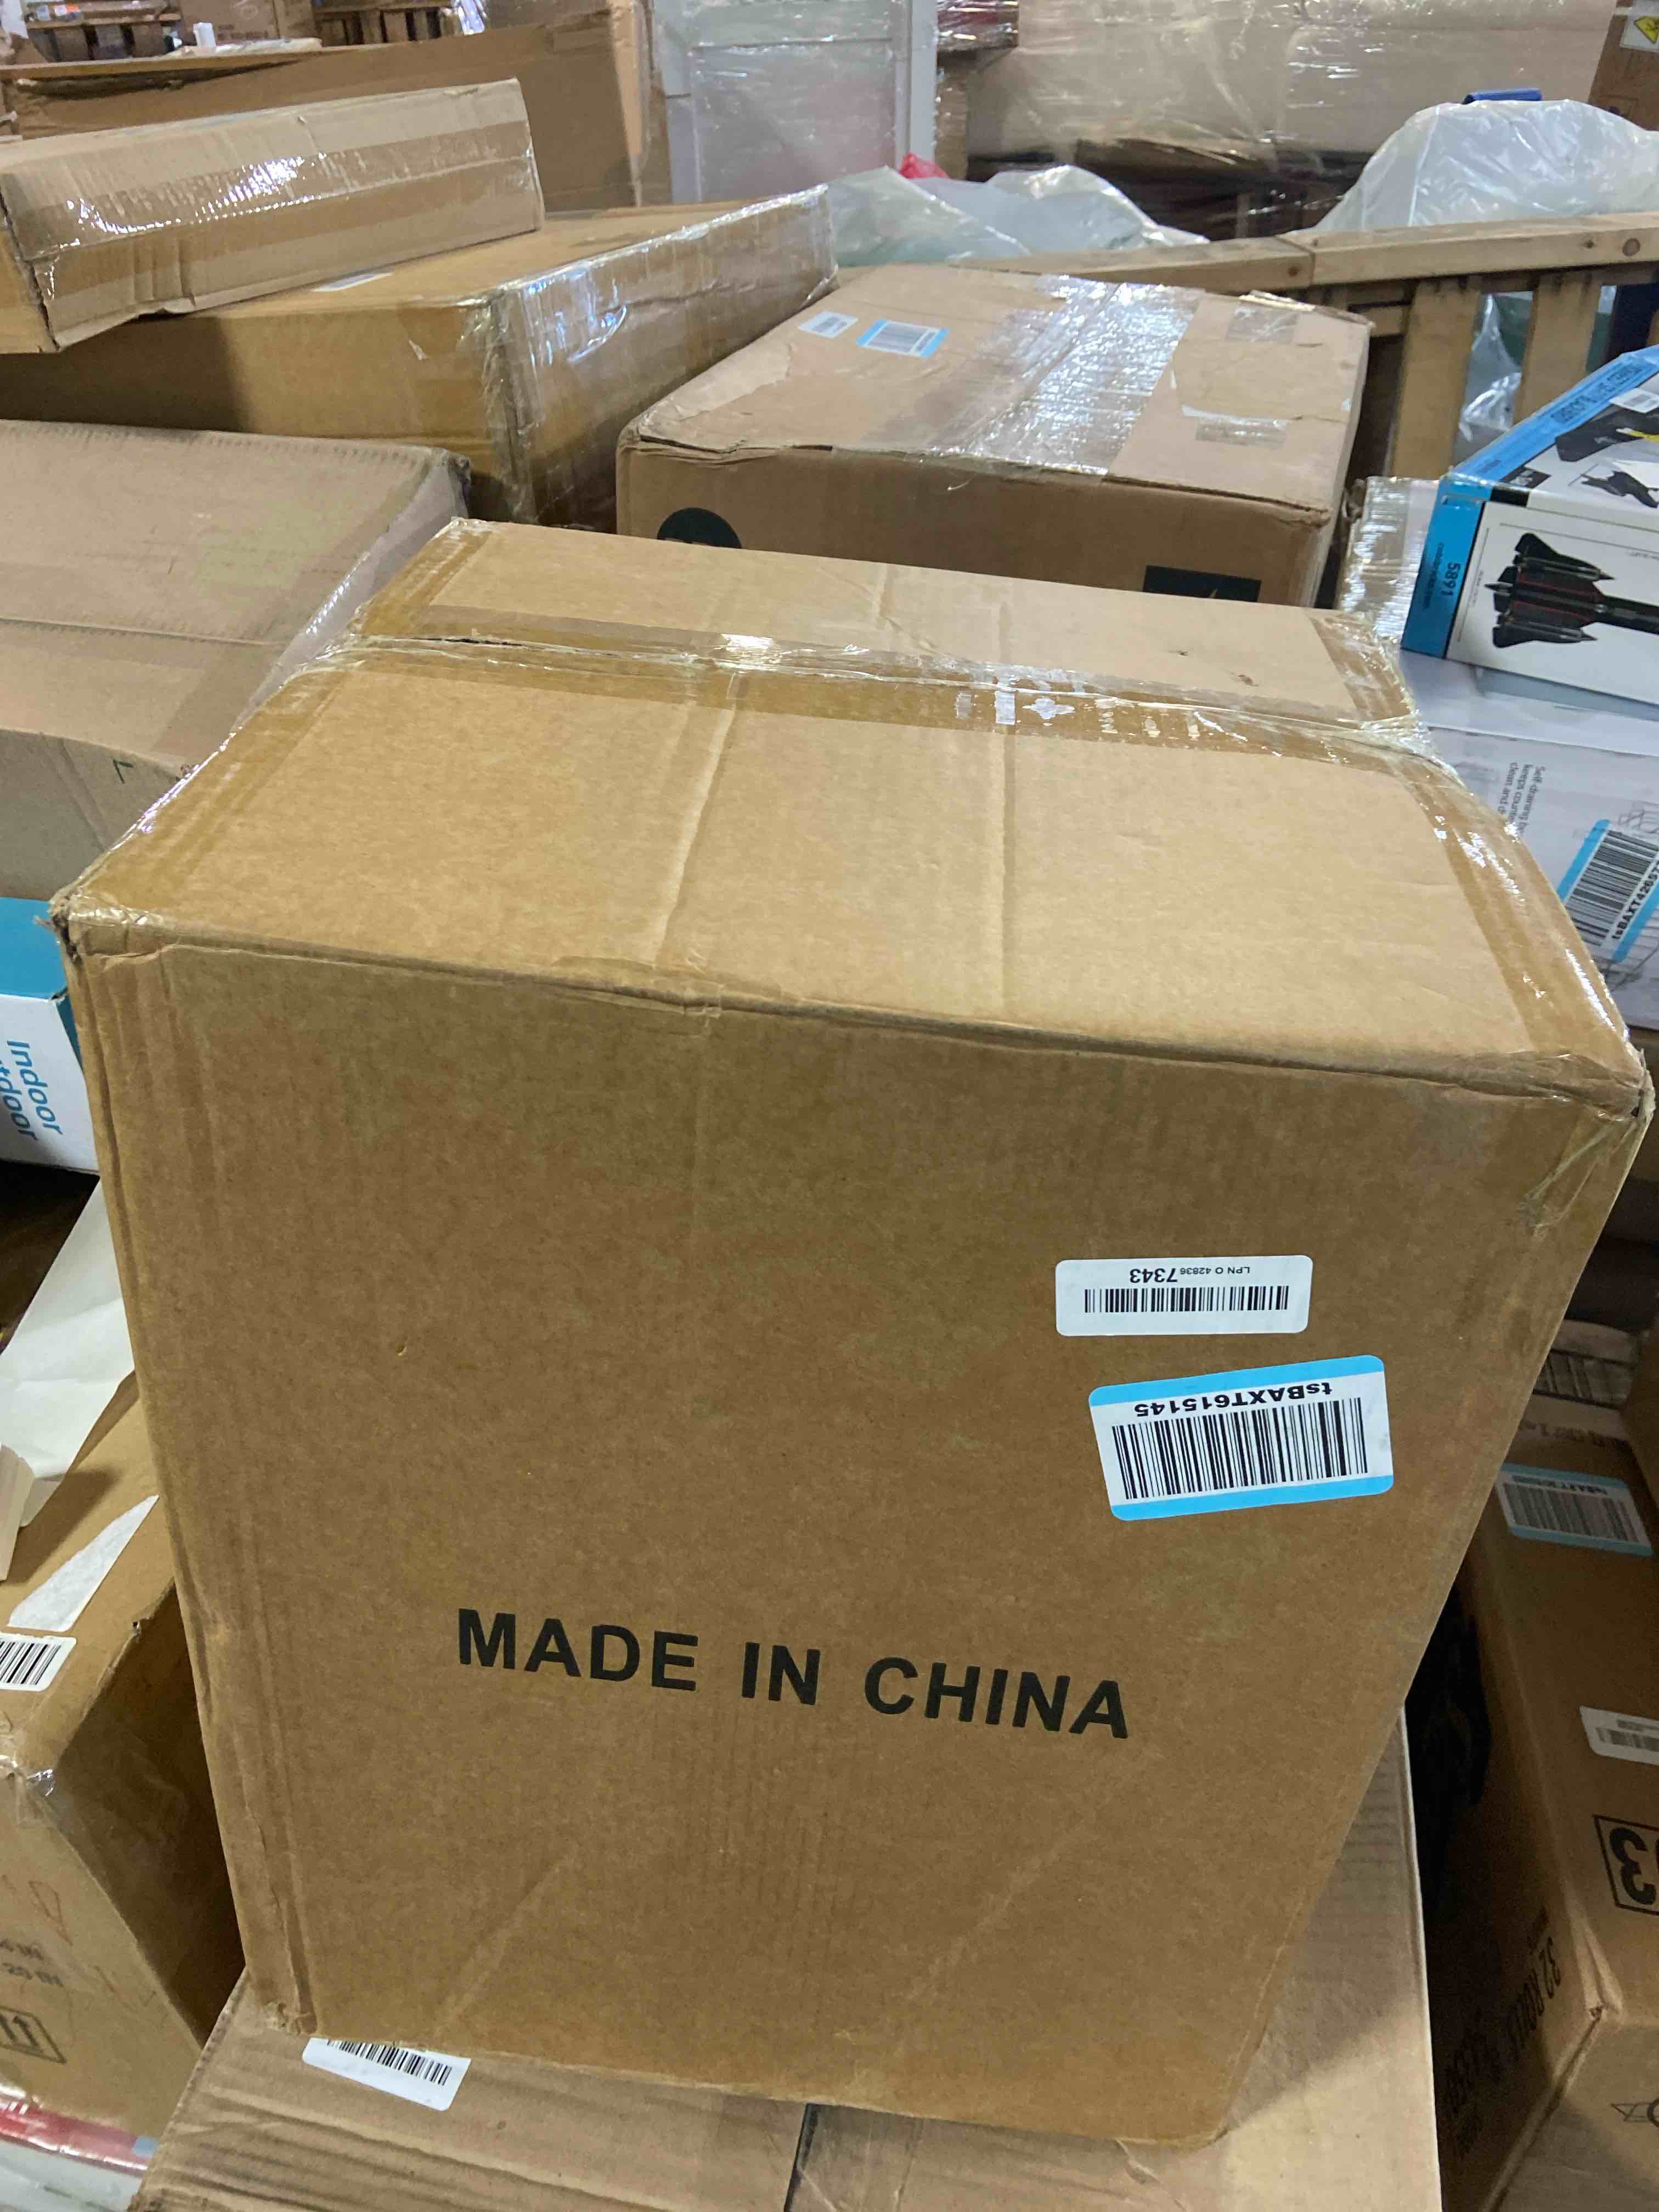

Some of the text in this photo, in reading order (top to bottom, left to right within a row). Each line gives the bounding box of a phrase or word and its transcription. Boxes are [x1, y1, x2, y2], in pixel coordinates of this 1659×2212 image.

[0, 1058, 38, 1142] tdoor
[7, 1039, 64, 1136] Indoor
[1129, 1267, 1178, 1283] 7343
[1180, 1266, 1212, 1276] 42836
[1227, 1266, 1251, 1274] LPN
[1134, 1381, 1333, 1418] tsBAXT615145
[459, 1608, 1128, 1739] MADE IN CHINA
